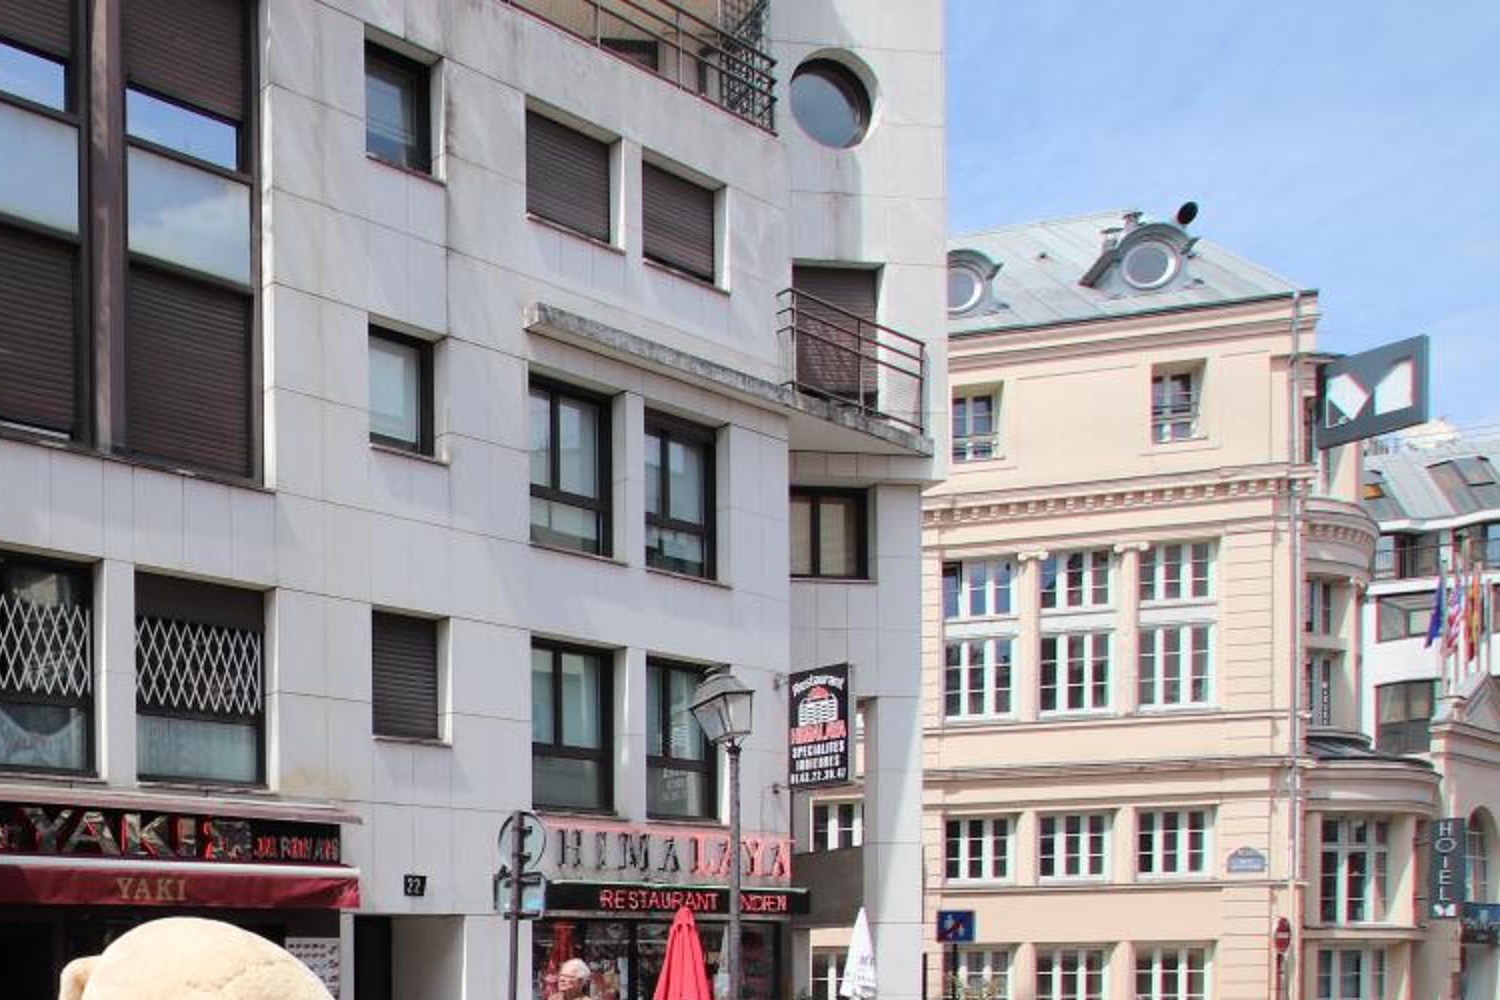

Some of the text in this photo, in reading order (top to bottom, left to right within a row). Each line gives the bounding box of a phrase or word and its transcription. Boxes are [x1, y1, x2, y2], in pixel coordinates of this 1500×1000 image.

[791, 674, 845, 697] Restaurant
[22, 807, 196, 859] YAKI
[556, 828, 791, 877] HIMALAYA
[115, 877, 188, 901] YAKI
[407, 877, 421, 895] 22
[599, 888, 788, 912] RESTAURANT NDIEN
